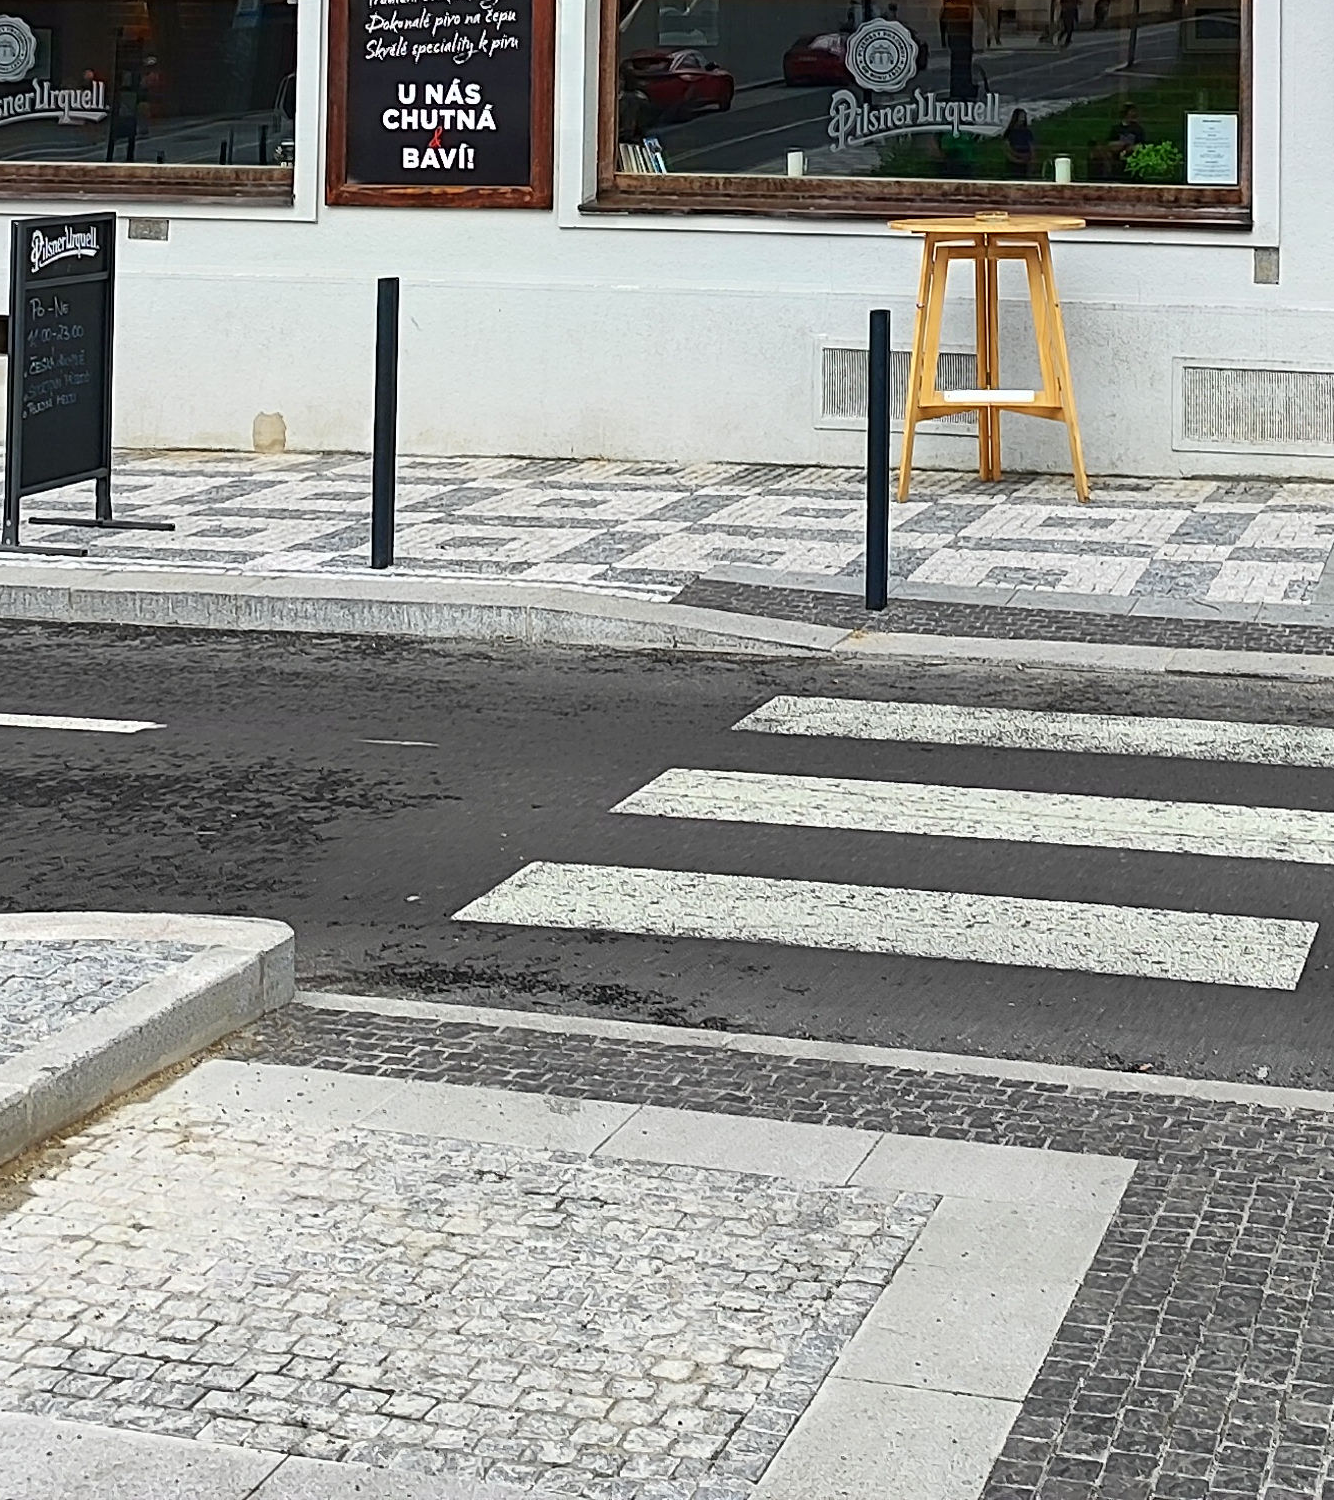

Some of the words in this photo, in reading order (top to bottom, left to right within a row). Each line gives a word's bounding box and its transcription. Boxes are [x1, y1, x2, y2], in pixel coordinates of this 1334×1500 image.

[365, 7, 432, 34] Dokonalé
[432, 12, 461, 37] pivo
[464, 13, 481, 25] na
[485, 8, 517, 31] čepu
[365, 35, 408, 61] Skvělé
[411, 30, 479, 64] speciality
[479, 29, 488, 53] k
[489, 34, 518, 58] pivu
[32, 78, 105, 122] Urquell
[398, 83, 416, 105] U
[425, 78, 482, 105] NÁS
[382, 103, 497, 130] CHUTNÁ
[827, 89, 917, 152] Pilsner
[914, 88, 1000, 138] Urquell
[428, 126, 443, 148] &
[402, 143, 475, 169] BAVÍ!
[30, 229, 67, 273] Pilsner
[64, 225, 97, 259] Urquell
